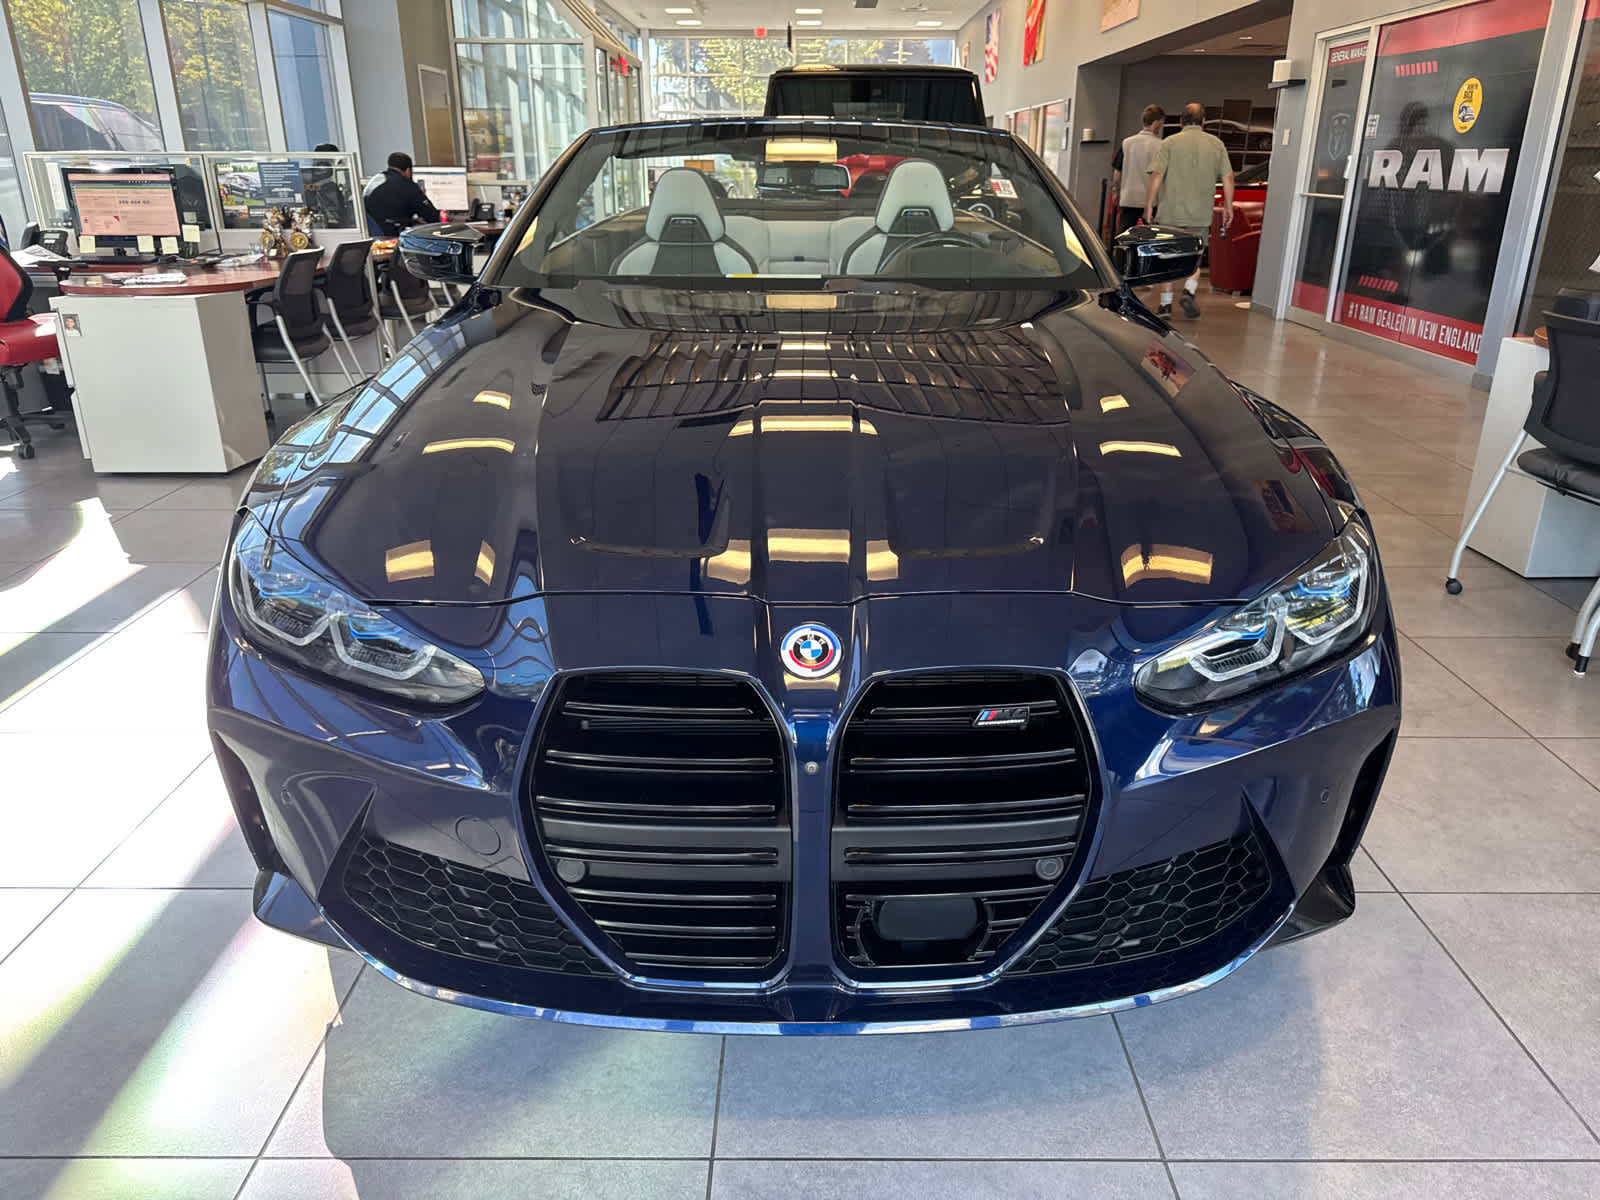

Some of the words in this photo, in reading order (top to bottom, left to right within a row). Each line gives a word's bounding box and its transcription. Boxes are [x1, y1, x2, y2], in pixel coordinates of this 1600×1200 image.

[1367, 148, 1510, 193] RAM
[1347, 301, 1359, 320] #1
[1358, 303, 1376, 324] RAM
[1375, 308, 1406, 333] DEALER
[1405, 317, 1417, 337] IN
[1417, 319, 1439, 342] NEW
[1438, 325, 1482, 354] ENGLAND
[795, 633, 828, 646] BMW
